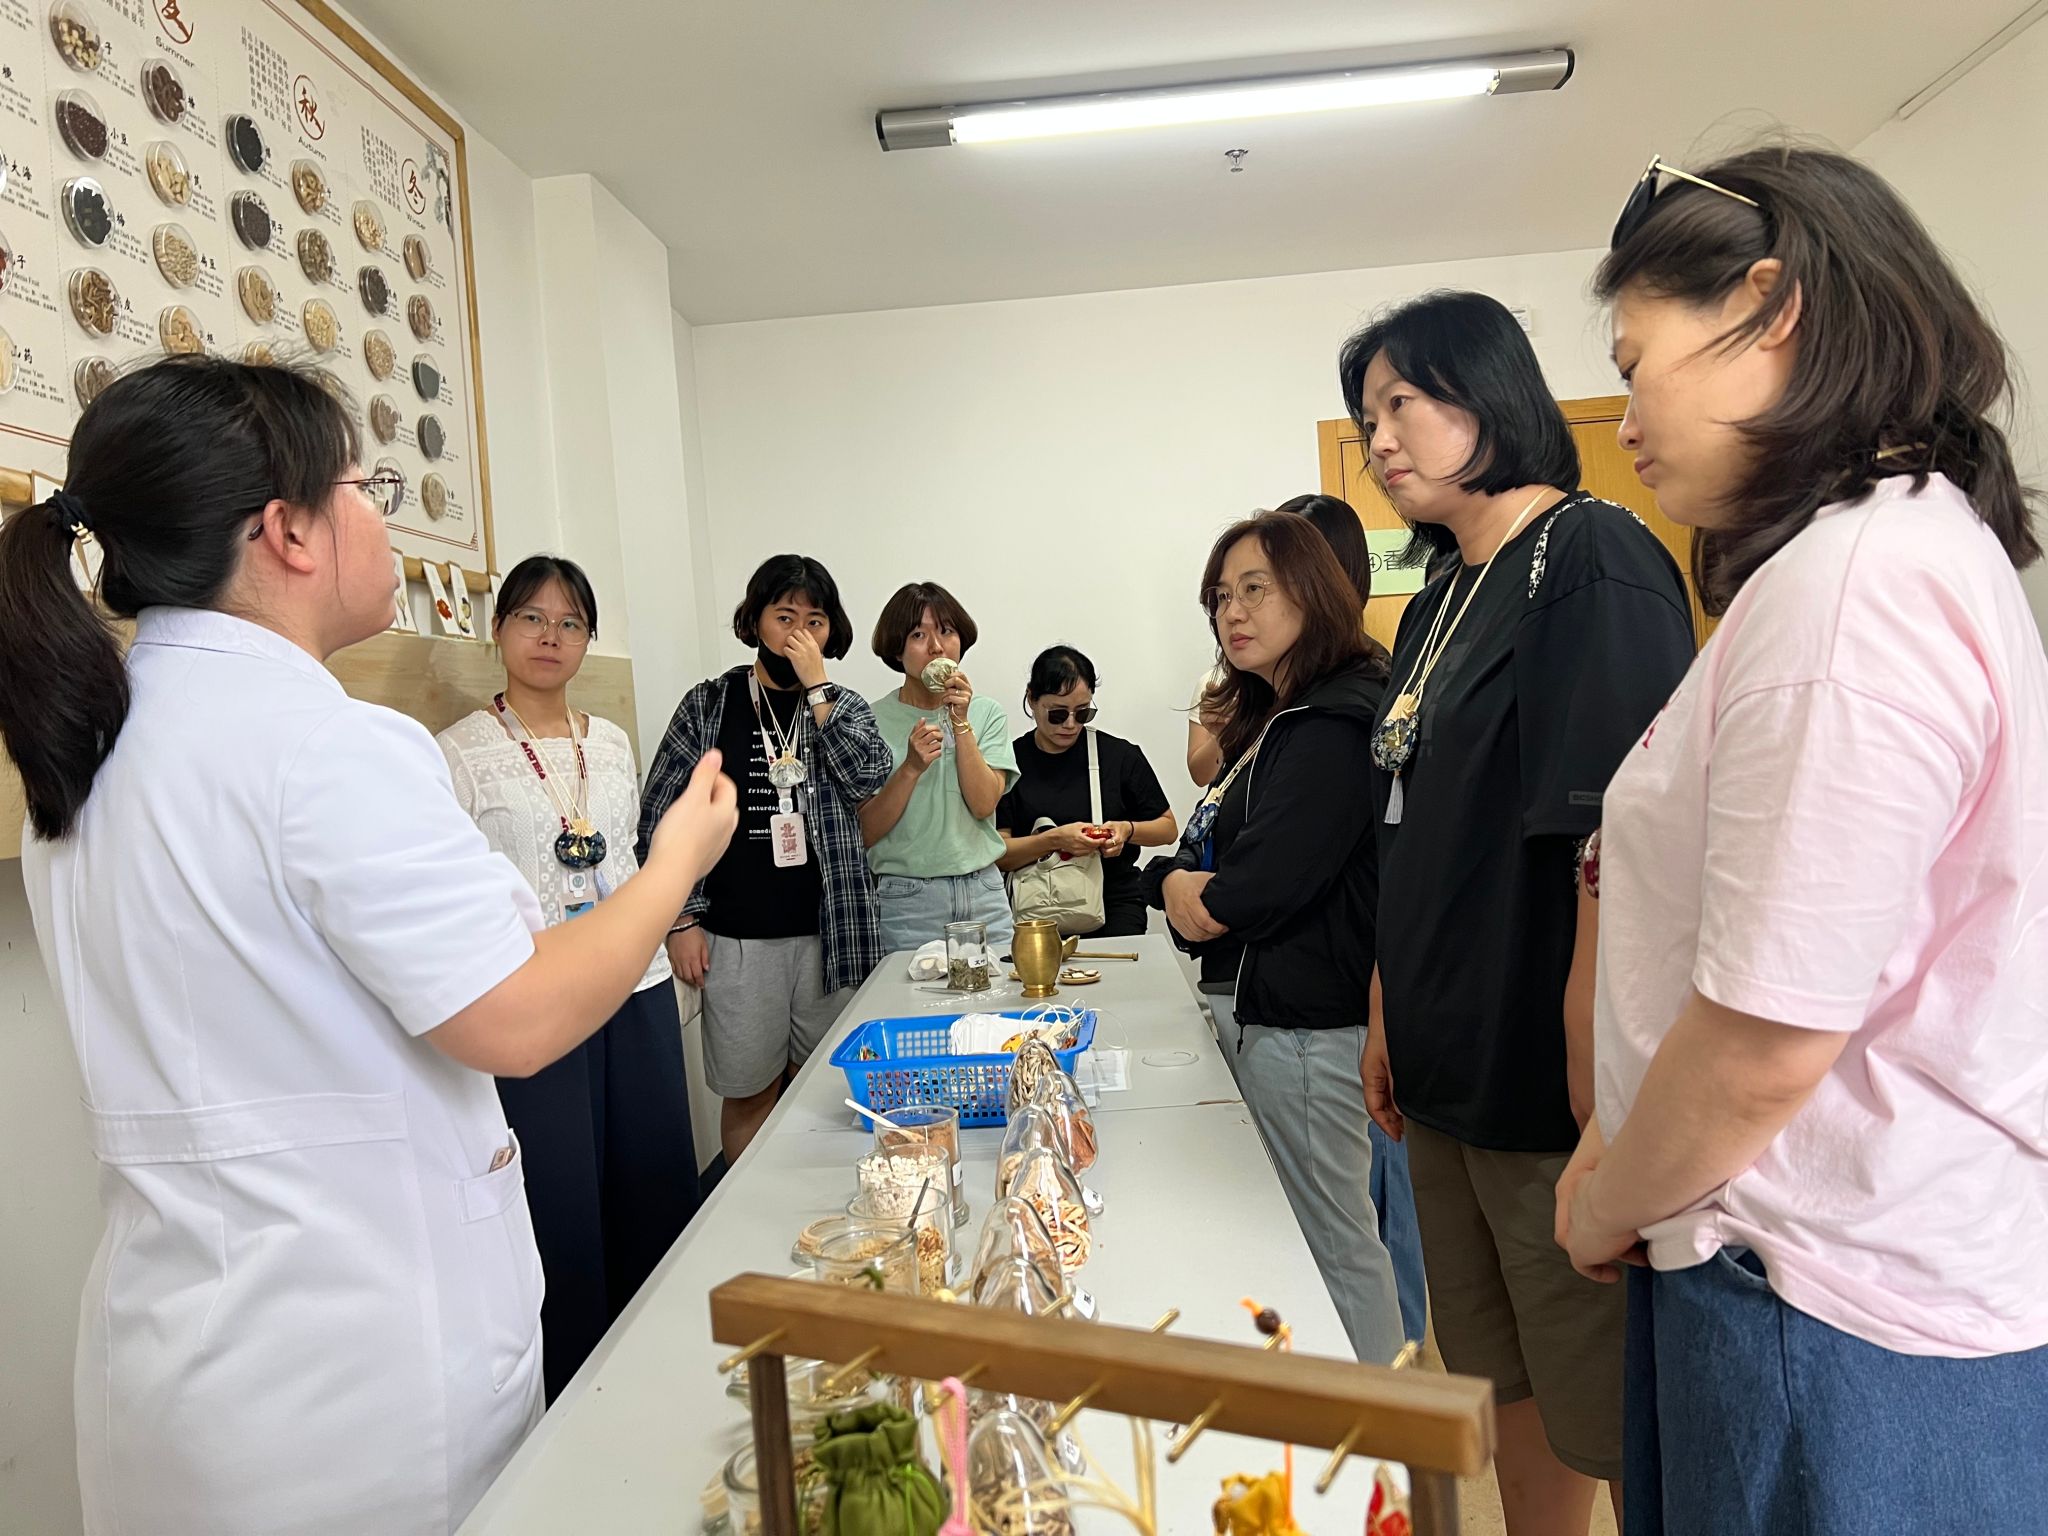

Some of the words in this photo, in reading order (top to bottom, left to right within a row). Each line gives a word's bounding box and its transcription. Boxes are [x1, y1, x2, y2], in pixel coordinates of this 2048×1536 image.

[155, 35, 195, 68] Summer
[298, 86, 323, 133] 秋
[298, 136, 327, 161] Autumn
[408, 169, 424, 205] 冬
